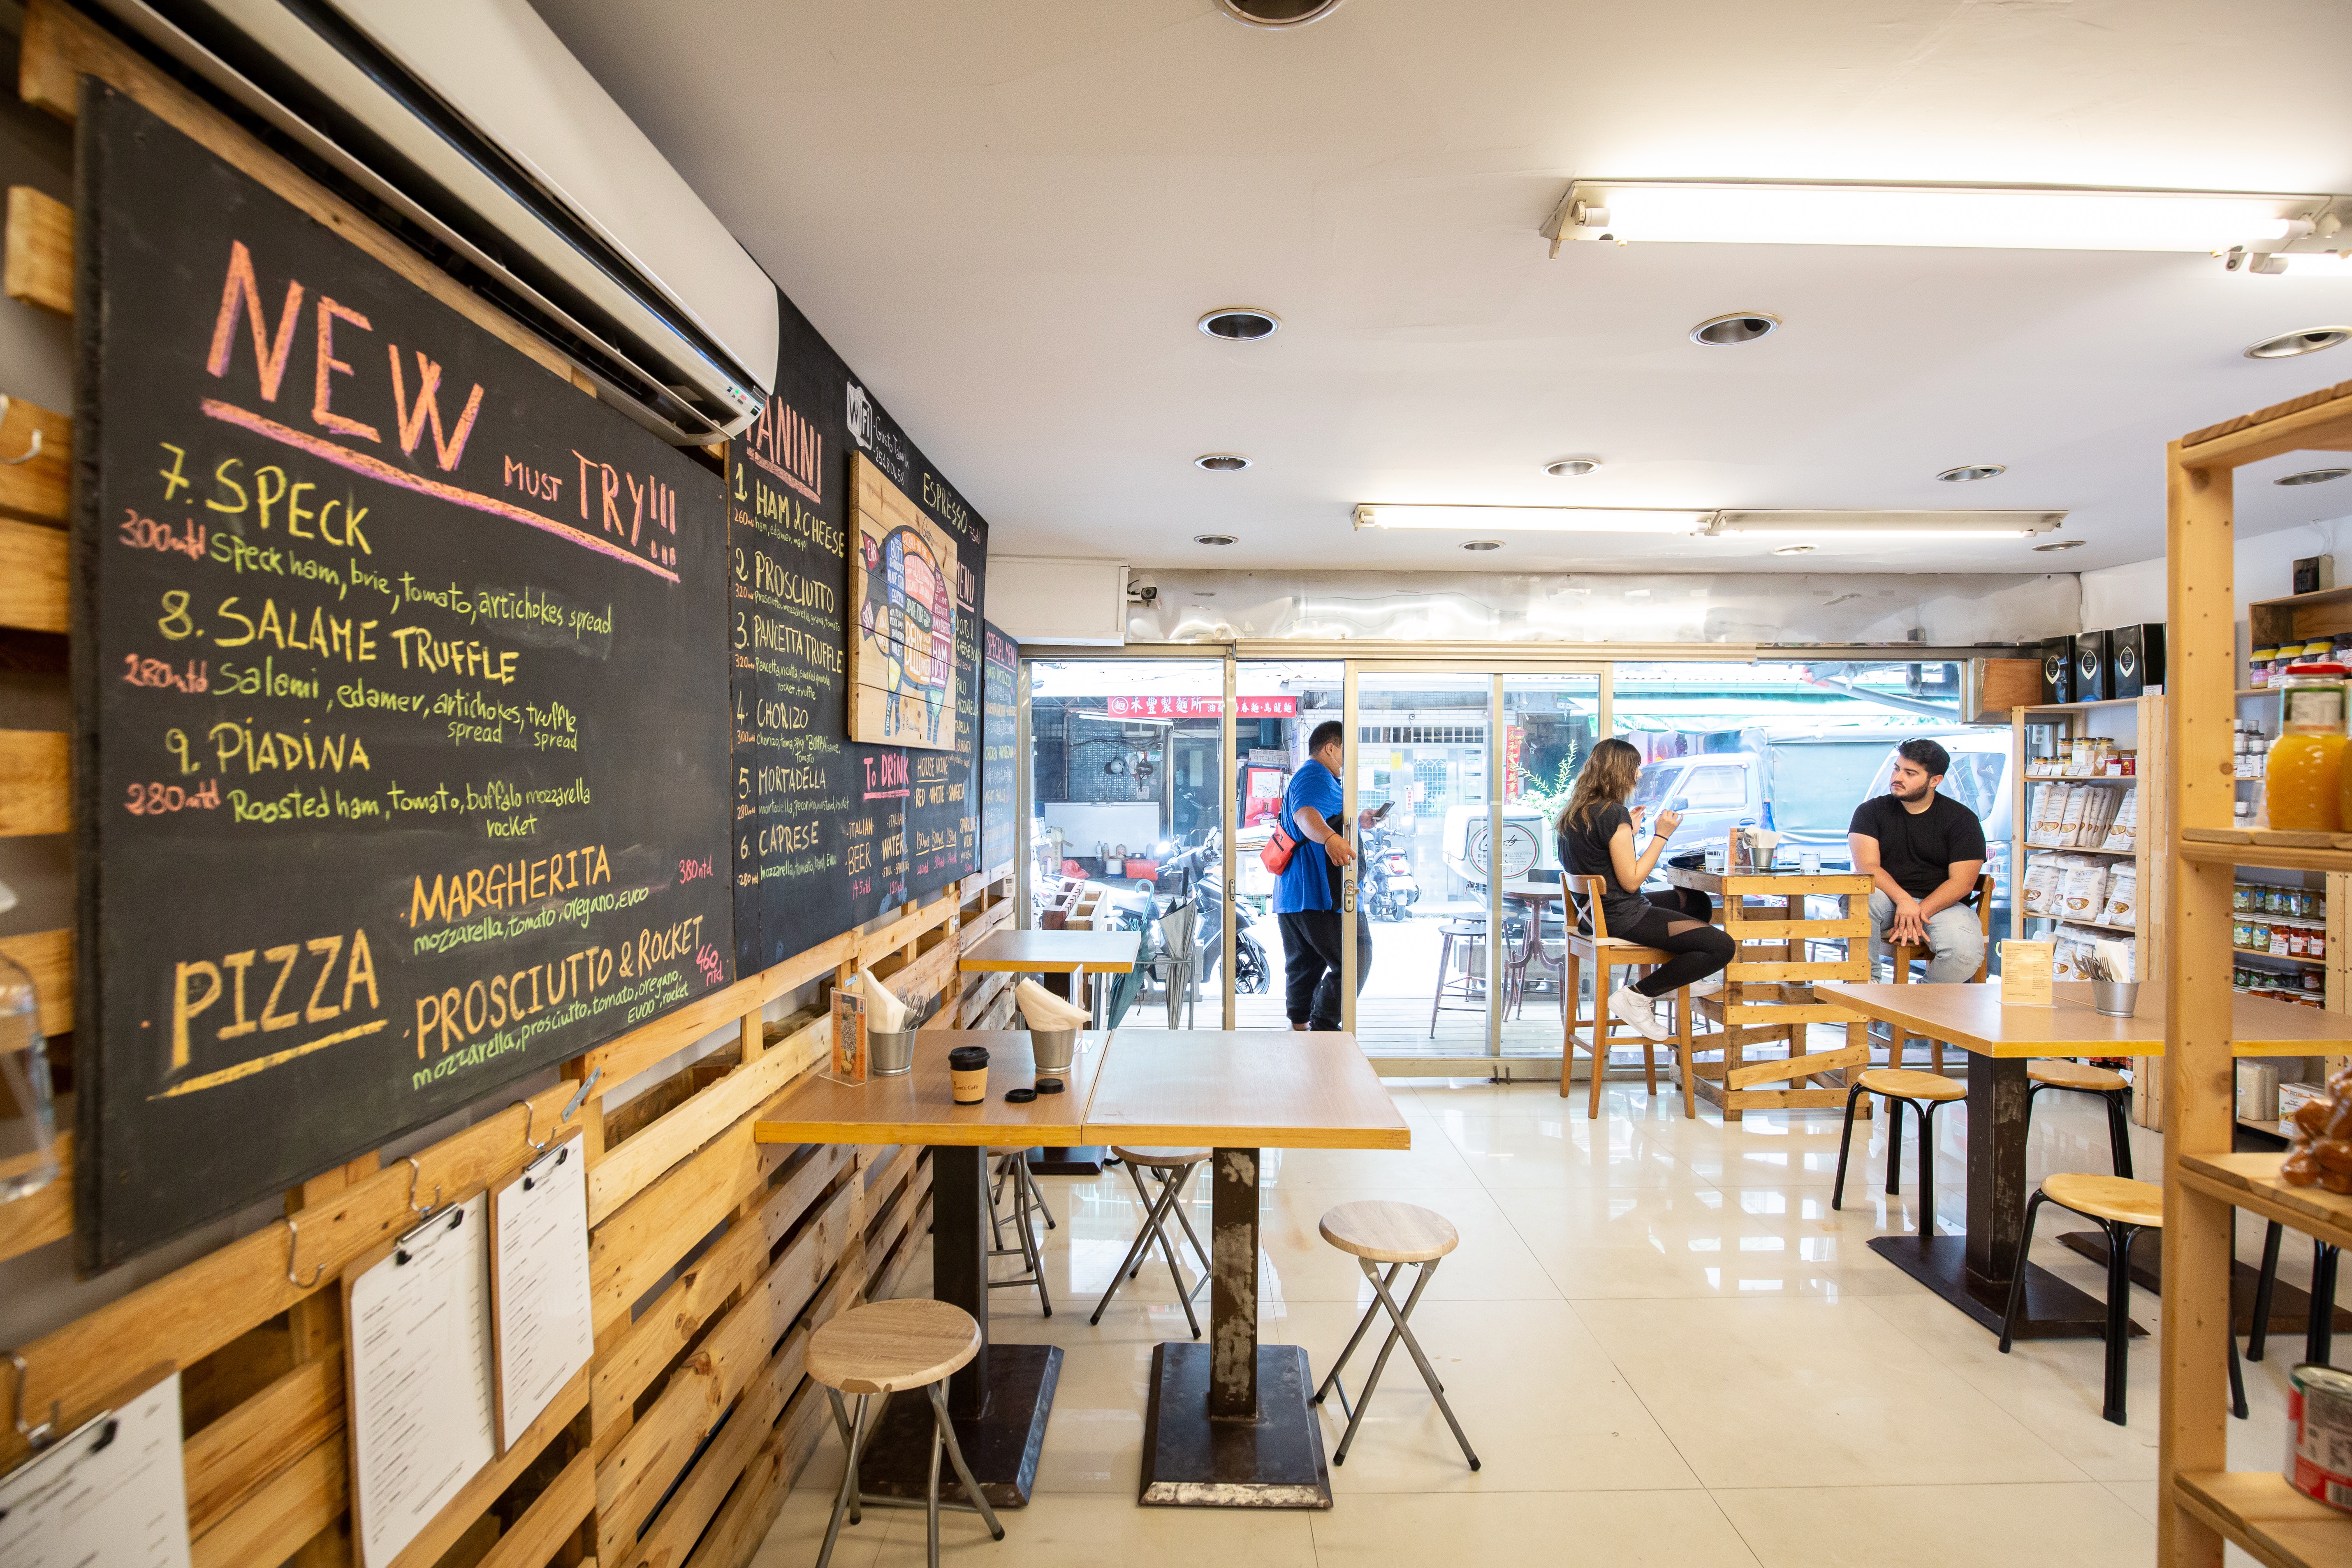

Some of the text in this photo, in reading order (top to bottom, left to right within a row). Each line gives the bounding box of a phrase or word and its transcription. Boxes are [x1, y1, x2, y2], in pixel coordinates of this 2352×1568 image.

[206, 239, 676, 566] NEW MUST TRY!!!
[875, 416, 893, 453] Gusto
[875, 446, 904, 486] 25180458
[160, 442, 372, 554] 7. SPECK
[923, 472, 967, 534] ESPRESSO
[756, 478, 844, 558] HAM & CHEESE
[867, 540, 877, 562] EAR
[890, 540, 902, 564] BUTT
[210, 532, 284, 574] Speck
[479, 586, 564, 628] artichokes
[568, 603, 612, 639] spread
[755, 551, 834, 614] PROSCIUTTO
[891, 588, 904, 604] COPPA
[906, 598, 916, 619] SPARE
[158, 590, 520, 686] 8. SALAME TRUFFLE
[735, 612, 843, 674] 3. PANCETTA TRUFFLE
[959, 618, 970, 639] CUTS
[932, 639, 948, 679] HAM
[957, 638, 971, 659] CHEESE
[987, 631, 1017, 668] SPECIAL MENU
[526, 700, 577, 732] truffle
[737, 690, 809, 730] 4. CHORIZO
[1114, 700, 1126, 711] 麵
[448, 720, 578, 752] spread spread
[739, 765, 826, 799] 5. MORTADELLA
[864, 757, 876, 791] To
[881, 753, 909, 788] DRINK
[917, 756, 935, 778] HOUSE
[936, 755, 948, 775] WINE
[466, 781, 522, 811] buffalo
[526, 777, 591, 807] mozzarella
[915, 783, 964, 809] RED WHITE SANGRIA
[985, 789, 994, 804] MEAT
[487, 814, 538, 838] rocket
[741, 820, 819, 859] 6. CAPRESE
[848, 842, 872, 877] BEER
[882, 831, 904, 862] WATER
[411, 844, 611, 928] MARGHERITA
[883, 865, 892, 878] STILL
[696, 943, 718, 974] 460
[171, 928, 379, 1070] PIZZA
[416, 915, 703, 1060] PROSCIUTTO & ROCKET
[663, 981, 689, 1008] rocket
